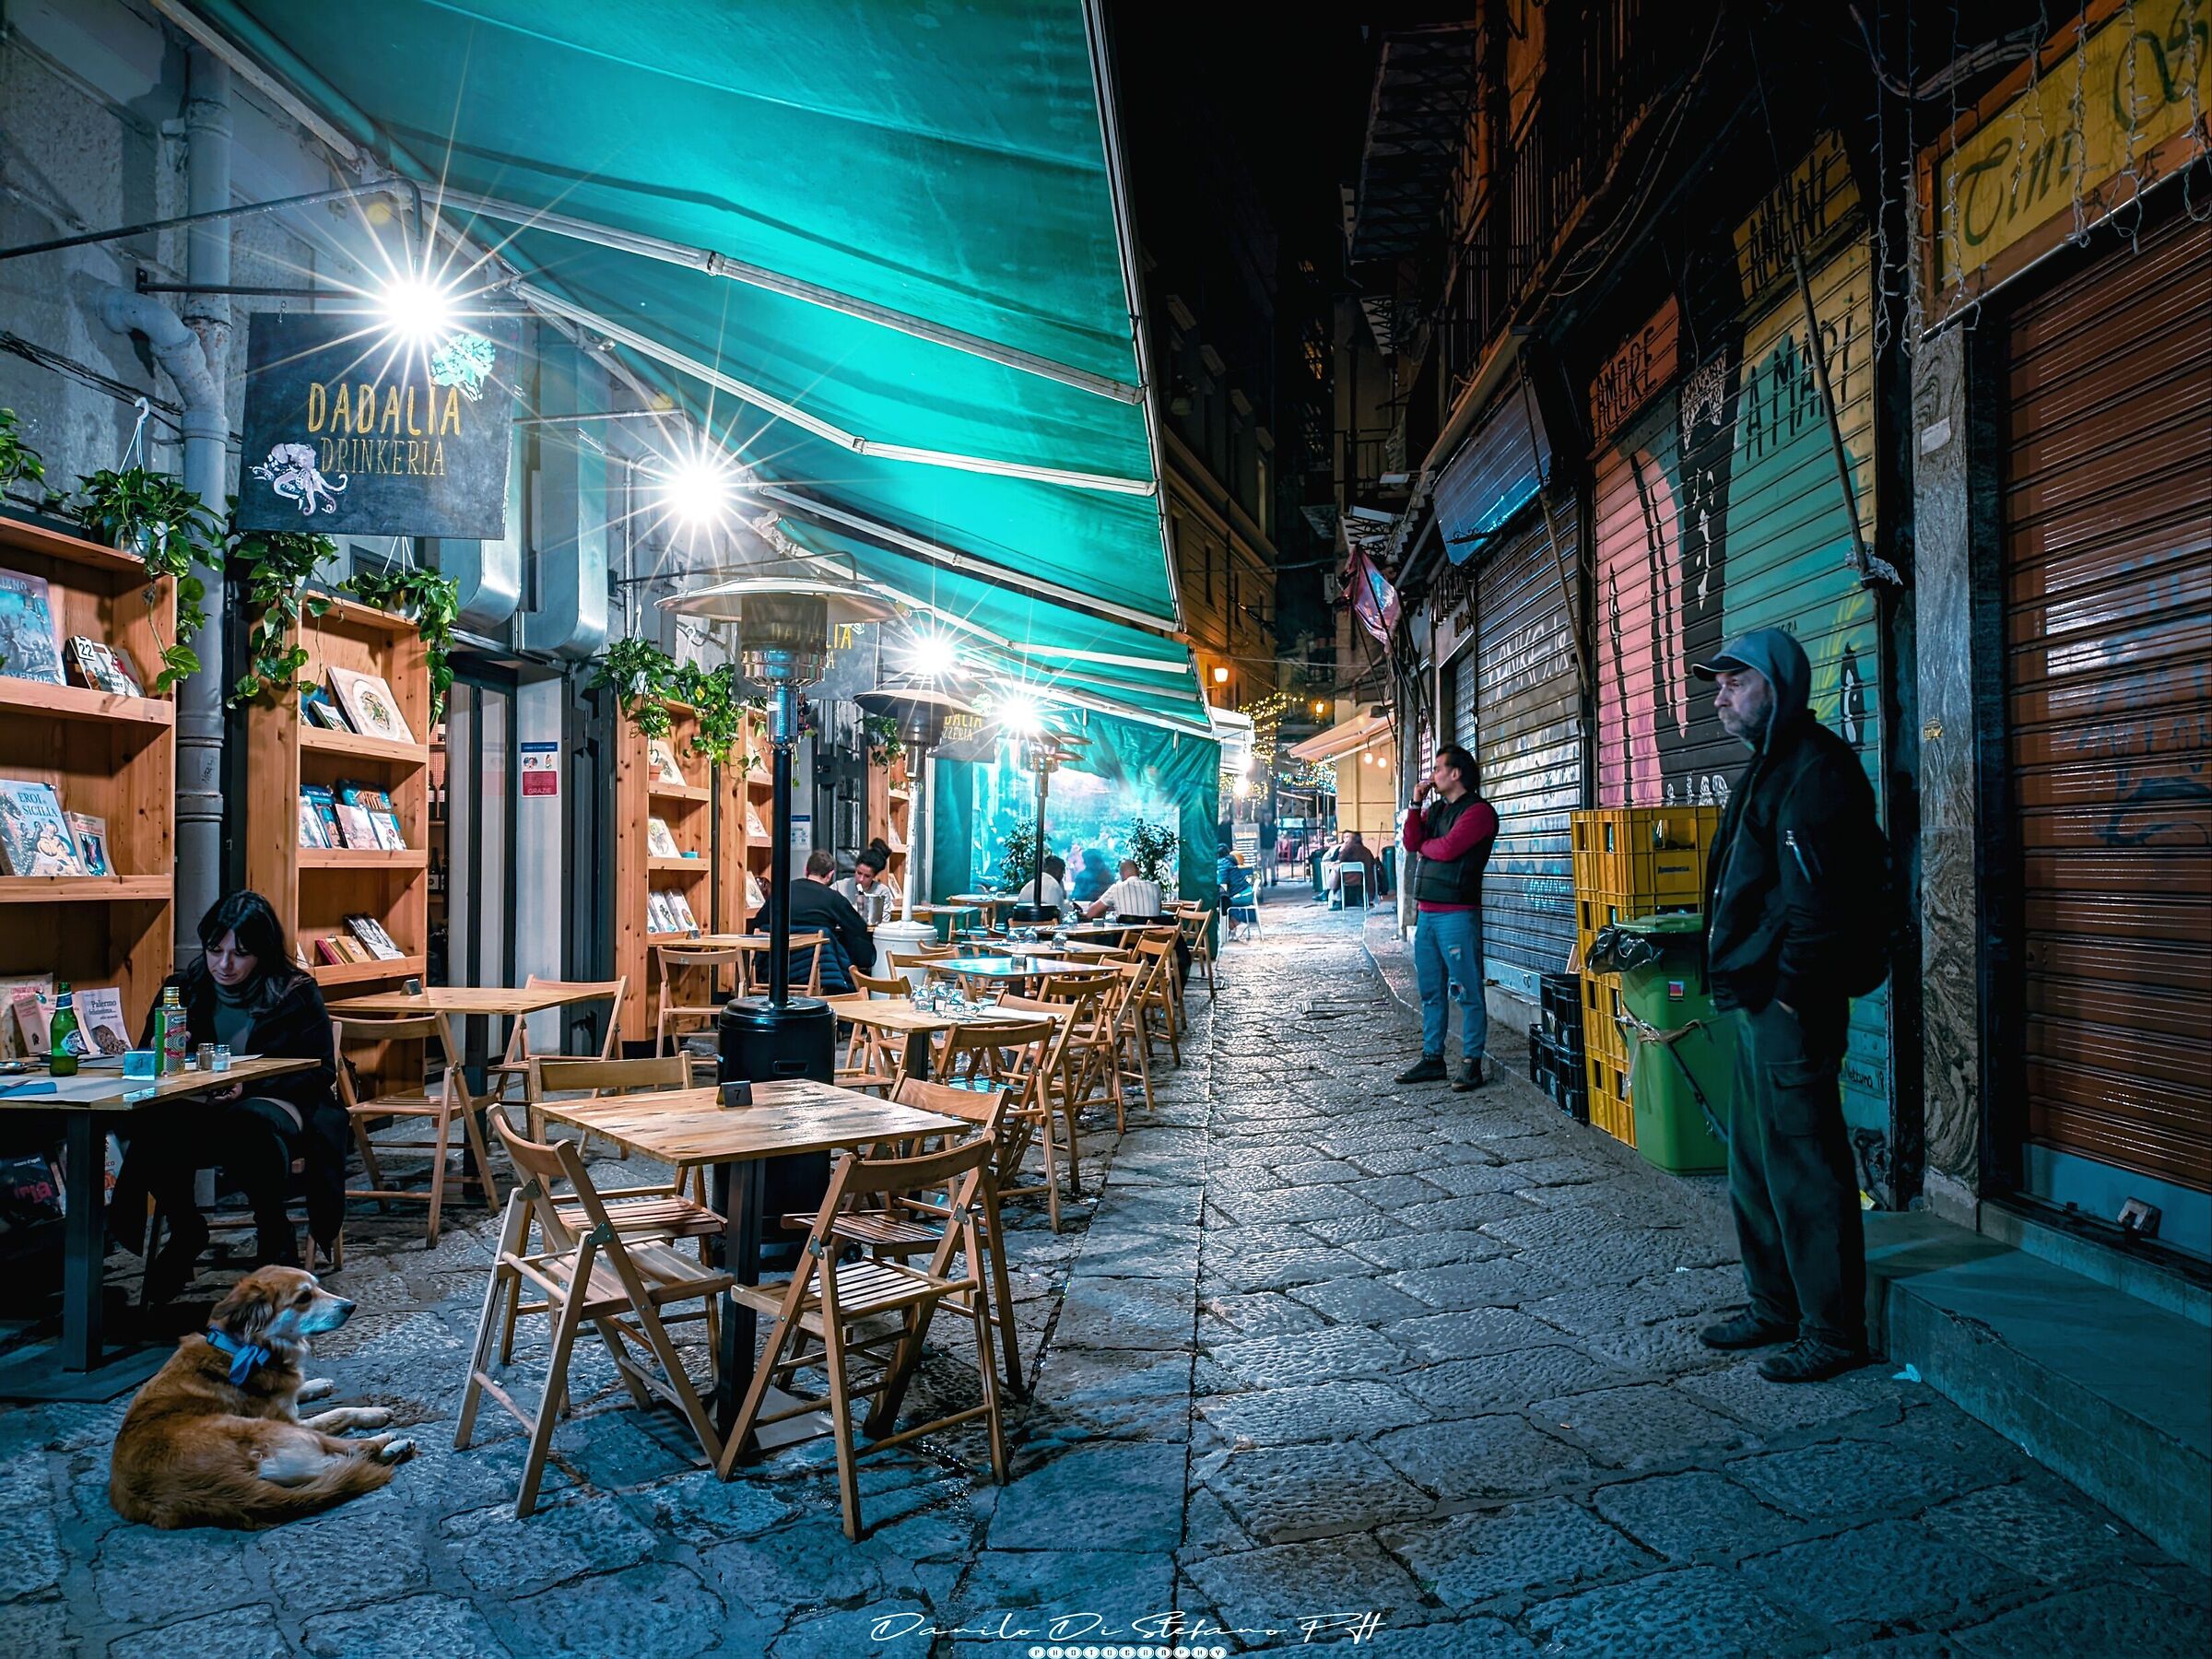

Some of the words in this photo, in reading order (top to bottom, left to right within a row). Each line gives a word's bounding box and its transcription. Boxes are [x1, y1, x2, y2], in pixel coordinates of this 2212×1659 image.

[308, 382, 461, 436] DADALIA
[320, 437, 445, 476] DRINKERIA
[78, 642, 95, 657] 22
[18, 793, 42, 805] EROI
[22, 805, 59, 818] SICILIA
[90, 999, 117, 1008] Palermo
